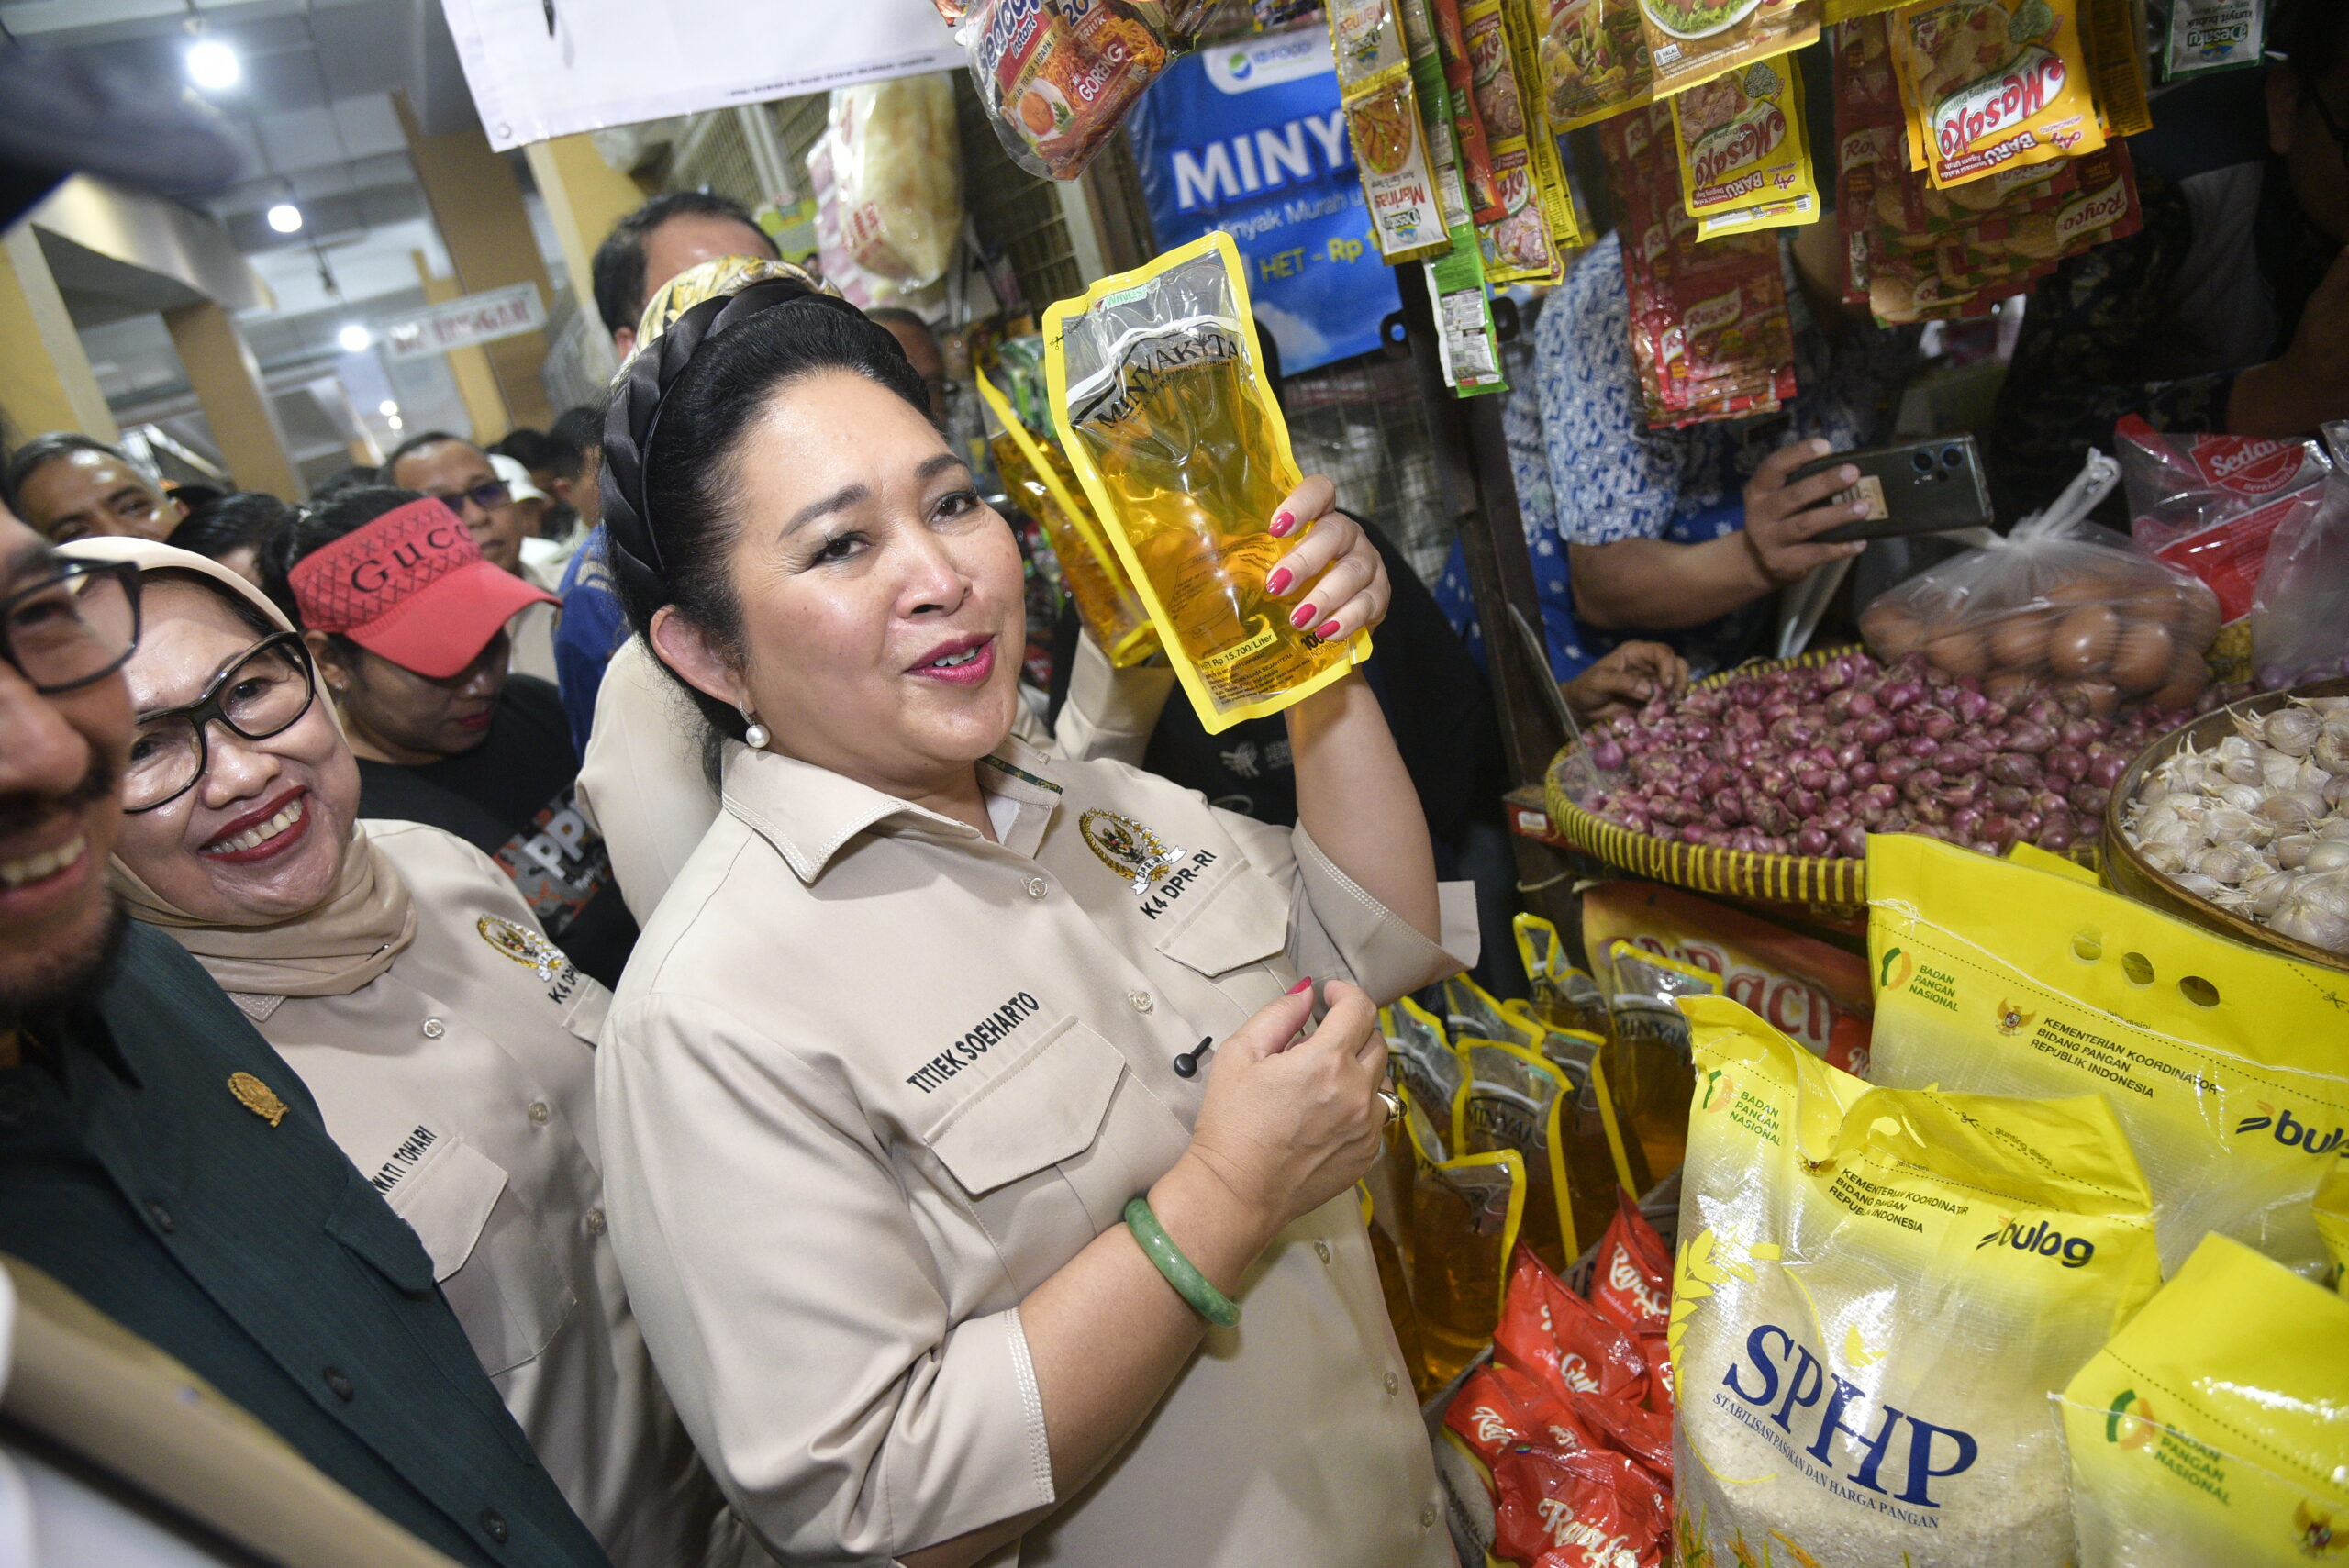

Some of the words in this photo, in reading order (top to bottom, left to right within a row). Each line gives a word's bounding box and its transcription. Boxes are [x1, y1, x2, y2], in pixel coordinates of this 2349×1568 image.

[1010, 14, 1038, 58] instant
[2188, 23, 2247, 47] Desaku
[1078, 43, 1124, 102] GORENG
[1967, 83, 2001, 99] Daging
[1937, 56, 2065, 159] Masako
[1939, 95, 1967, 121] Pilihan
[1694, 111, 1786, 189] Masako
[1984, 132, 2037, 166] BARU
[1725, 170, 1764, 199] BARU
[1940, 168, 1960, 180] Kaldu
[1285, 192, 1346, 223] Murah
[1375, 183, 1425, 209] Marinas
[2064, 189, 2126, 231] Royco
[1259, 247, 1307, 282] HET
[1328, 238, 1364, 264] Rp
[1094, 333, 1239, 429] MINYAKITA
[1212, 657, 1224, 667] Rp
[1224, 633, 1274, 662] 15.700/Liter
[1137, 854, 1167, 879] DPR-RI
[1139, 895, 1168, 920] K4
[1159, 849, 1218, 899] DPR-RI
[548, 979, 571, 1005] K4
[1913, 974, 1956, 998] PANGAN
[1919, 964, 1955, 984] BADAN
[1909, 984, 1959, 1013] NASIONAL
[905, 1048, 969, 1094] TITIEK
[954, 991, 1040, 1061] SOEHARTO
[2036, 1027, 2081, 1052] BIDANG
[2083, 1047, 2131, 1073] PANGAN
[2043, 1016, 2126, 1054] KEMENTERIAN
[2126, 1051, 2220, 1095] KOORDINATOR
[2030, 1039, 2087, 1070] REPUBLIK
[2087, 1063, 2155, 1099] INDONESIA
[1735, 1101, 1780, 1131] PANGAN
[1741, 1091, 1779, 1118] BADAN
[391, 1124, 438, 1166] TOHARI
[1729, 1111, 1781, 1147] NASIONAL
[1995, 1125, 2028, 1152] gunting
[2028, 1149, 2054, 1167] disini
[1835, 1176, 1873, 1207] BIDANG
[1870, 1208, 1924, 1234] INDONESIA
[1998, 1218, 2095, 1268] bulog
[1721, 1324, 1979, 1509] SPHP
[1712, 1392, 1776, 1444] STABILISASI
[1773, 1435, 1806, 1473] PASOKAN
[1804, 1465, 1827, 1489] DAN
[1828, 1480, 1876, 1511] HARGA
[1878, 1502, 1940, 1529] PANGAN
[2154, 1450, 2231, 1507] NASIONAL
[2160, 1436, 2226, 1484] PANGAN
